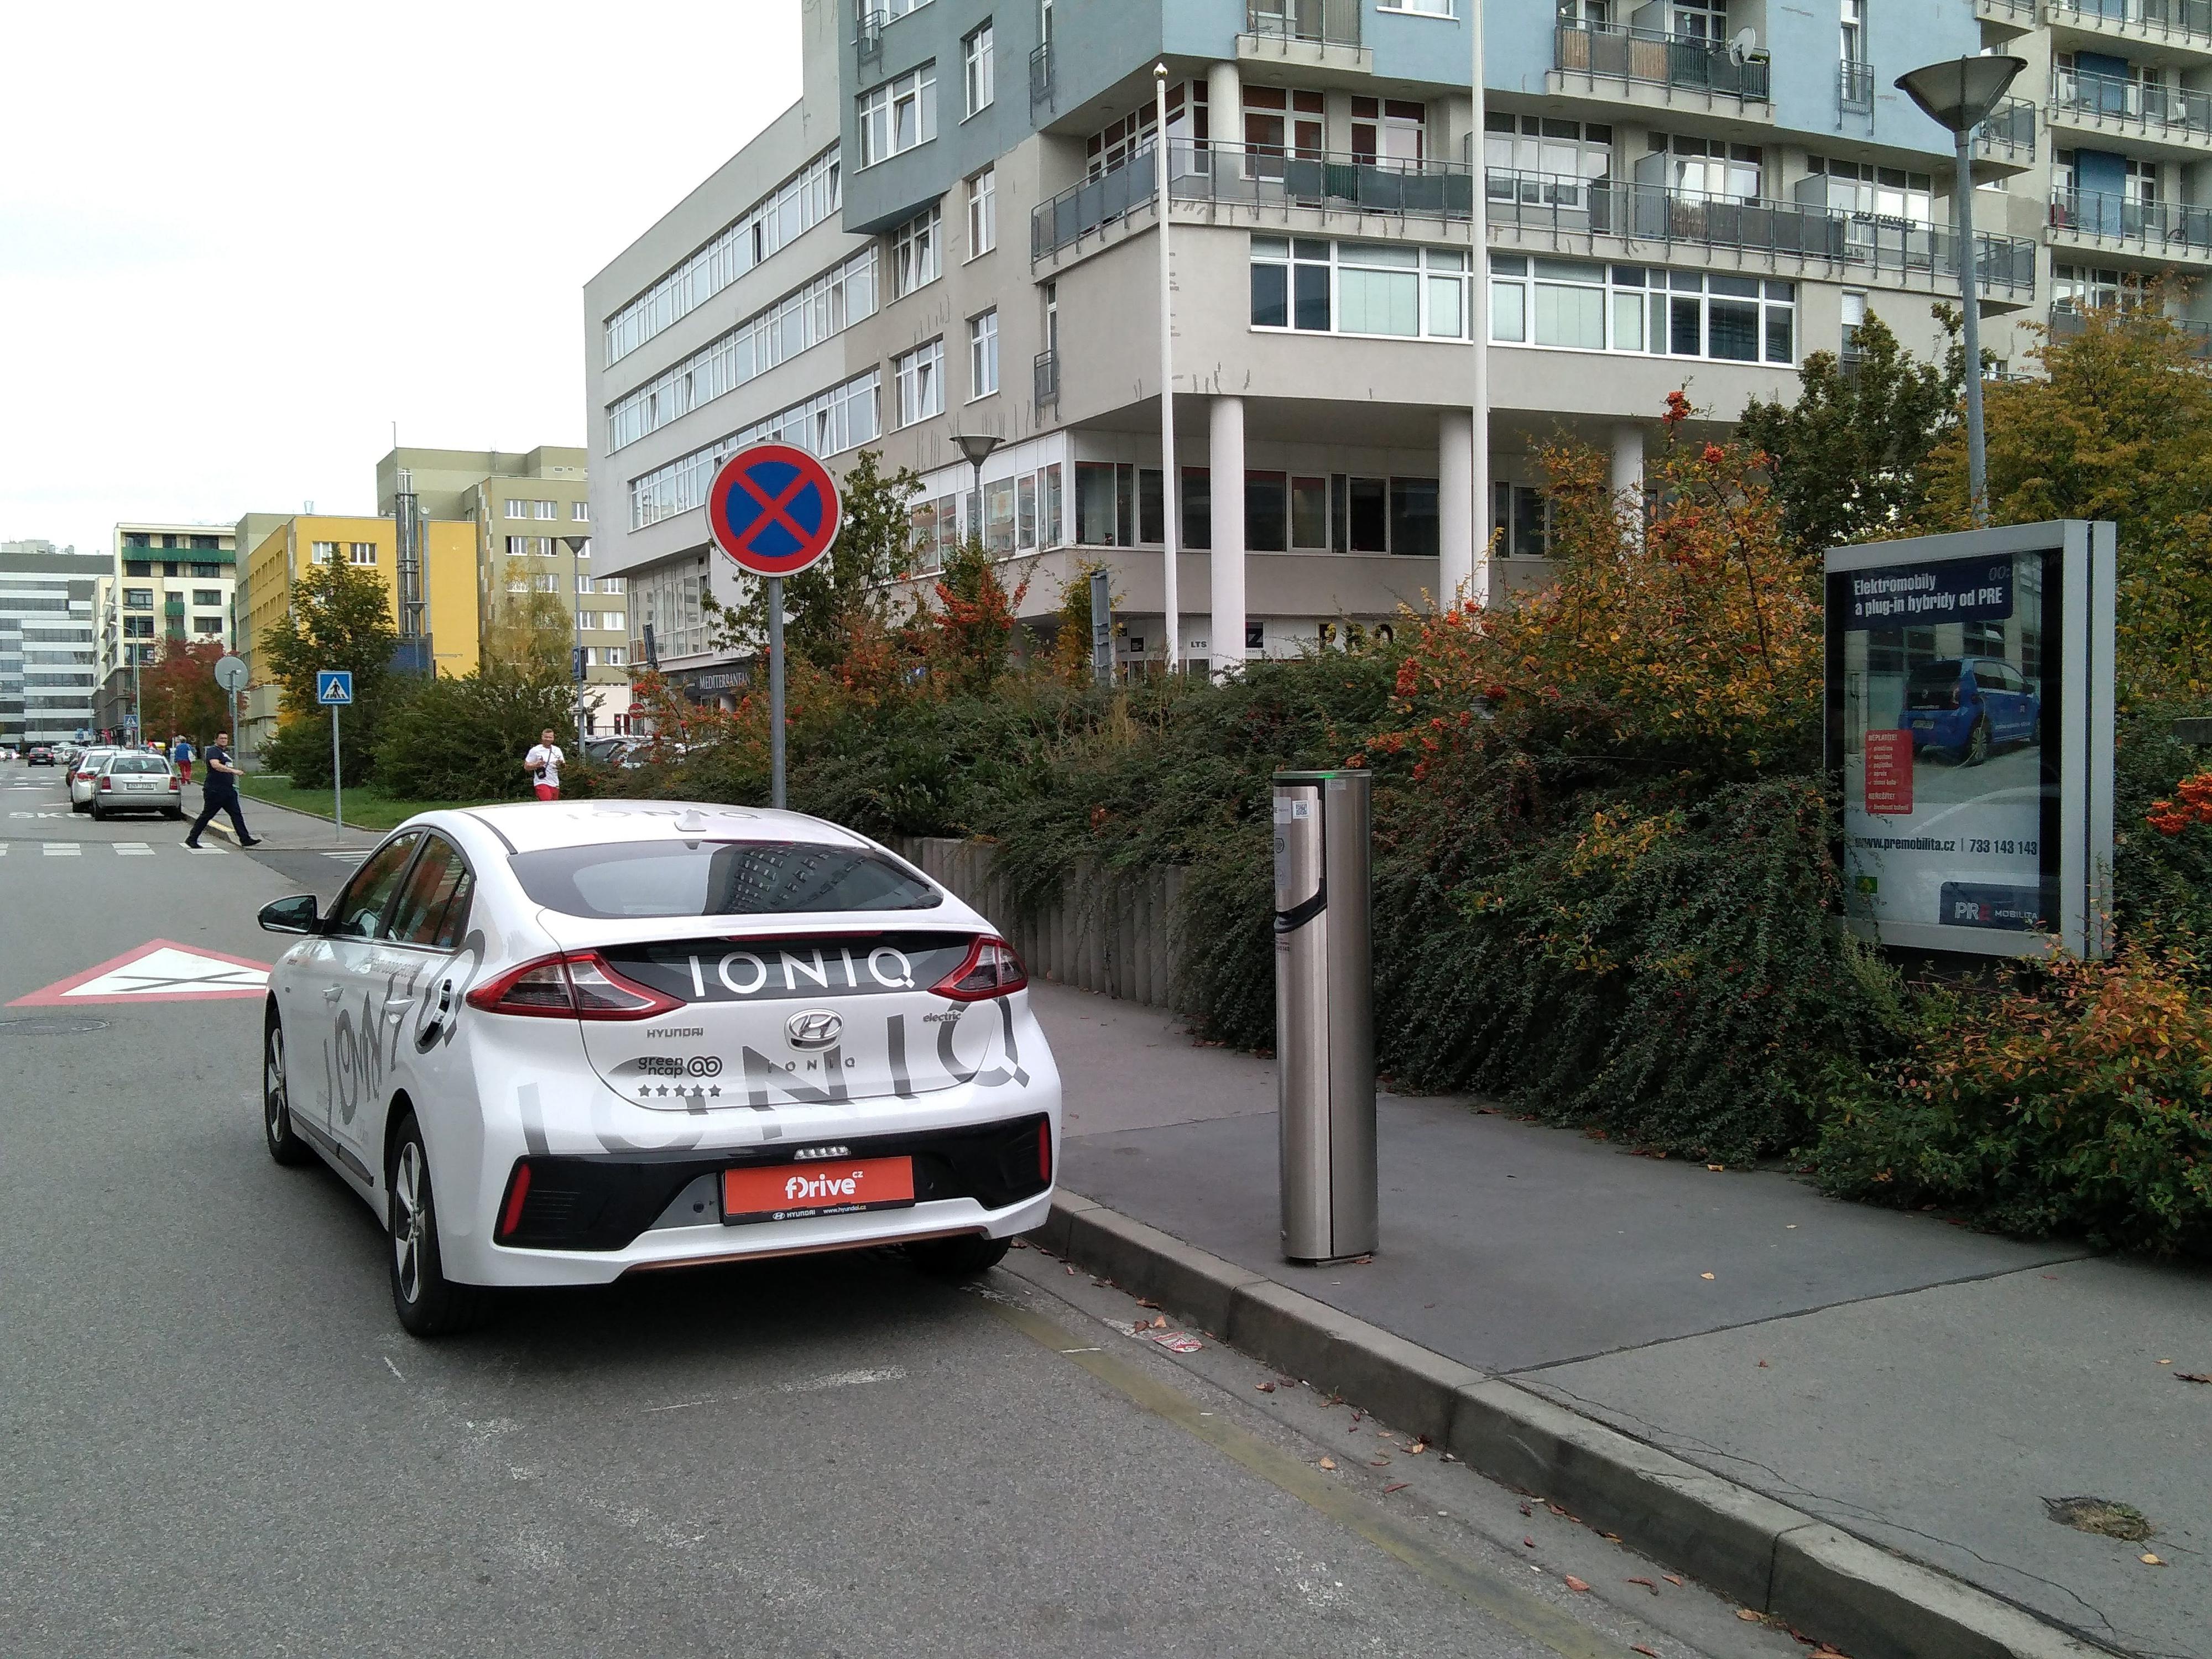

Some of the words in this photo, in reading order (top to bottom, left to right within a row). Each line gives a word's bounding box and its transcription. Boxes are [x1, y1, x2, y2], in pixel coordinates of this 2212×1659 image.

[1854, 573, 1936, 596] Elektromobily
[1855, 604, 1863, 616] a
[1865, 598, 1905, 617] plug-in
[1907, 591, 1956, 614] hybridy
[1959, 590, 1975, 607] od
[1979, 587, 2002, 605] PRE
[1970, 839, 1990, 853] 733
[1994, 840, 2014, 854] 143
[2018, 841, 2037, 855] 143
[1954, 901, 1990, 921] PRE
[1995, 910, 2038, 920] MOBILITA
[689, 946, 915, 997] IONIQ
[922, 1011, 962, 1022] electric
[647, 1027, 704, 1038] HYUNDAI
[638, 1057, 684, 1070] green
[767, 1057, 855, 1073] IONIQ
[648, 1067, 684, 1079] ncap
[787, 1209, 816, 1218] HYUNDAI
[823, 1204, 867, 1214] www.hyundai.cz
